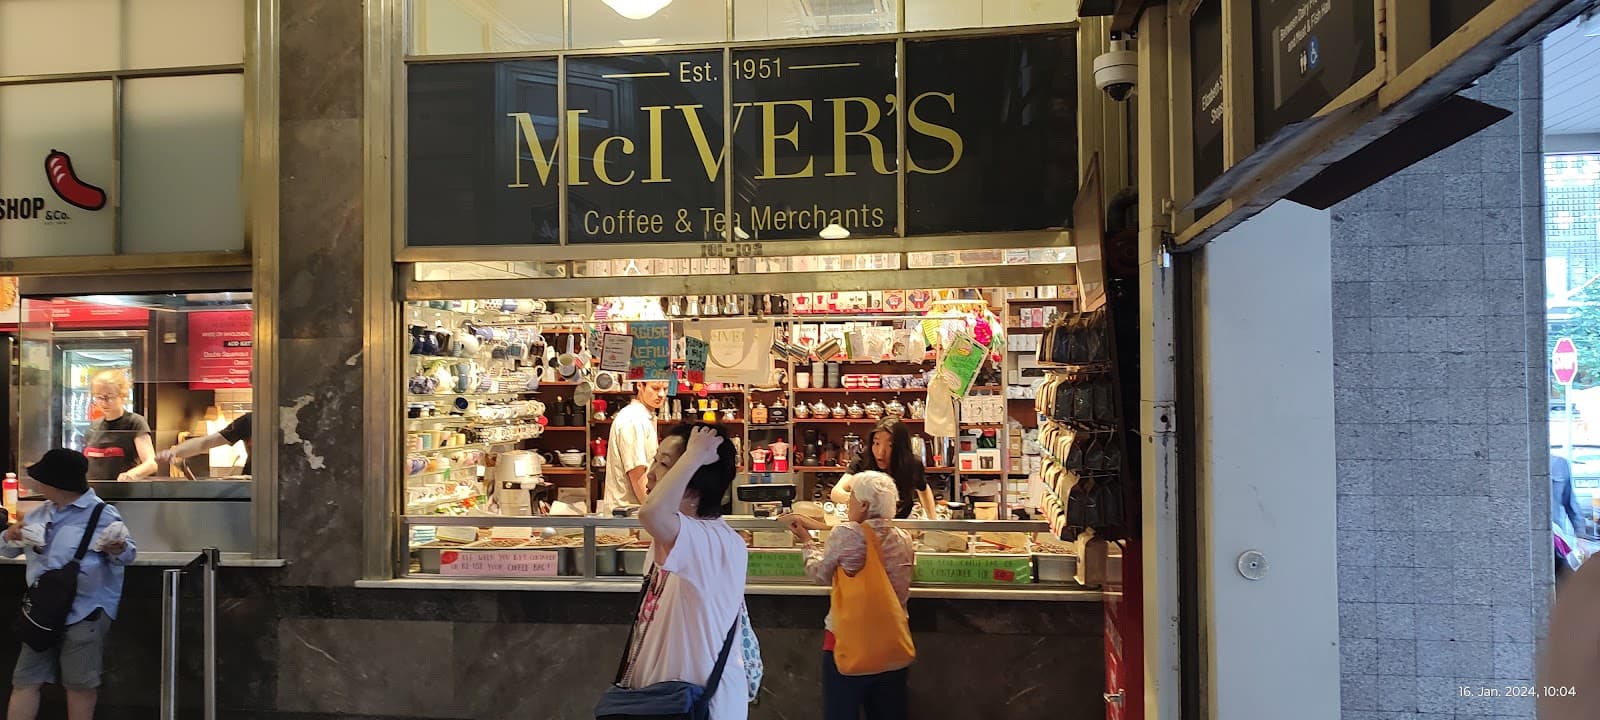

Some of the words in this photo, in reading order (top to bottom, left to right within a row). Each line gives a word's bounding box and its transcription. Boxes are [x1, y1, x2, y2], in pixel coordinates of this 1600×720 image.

[678, 61, 719, 83] Est.
[733, 56, 781, 80] 1951
[0, 197, 45, 220] SHOP
[583, 208, 664, 236] Coffee
[674, 207, 693, 234] &
[699, 206, 742, 233] Tea
[750, 203, 885, 231] Merchants
